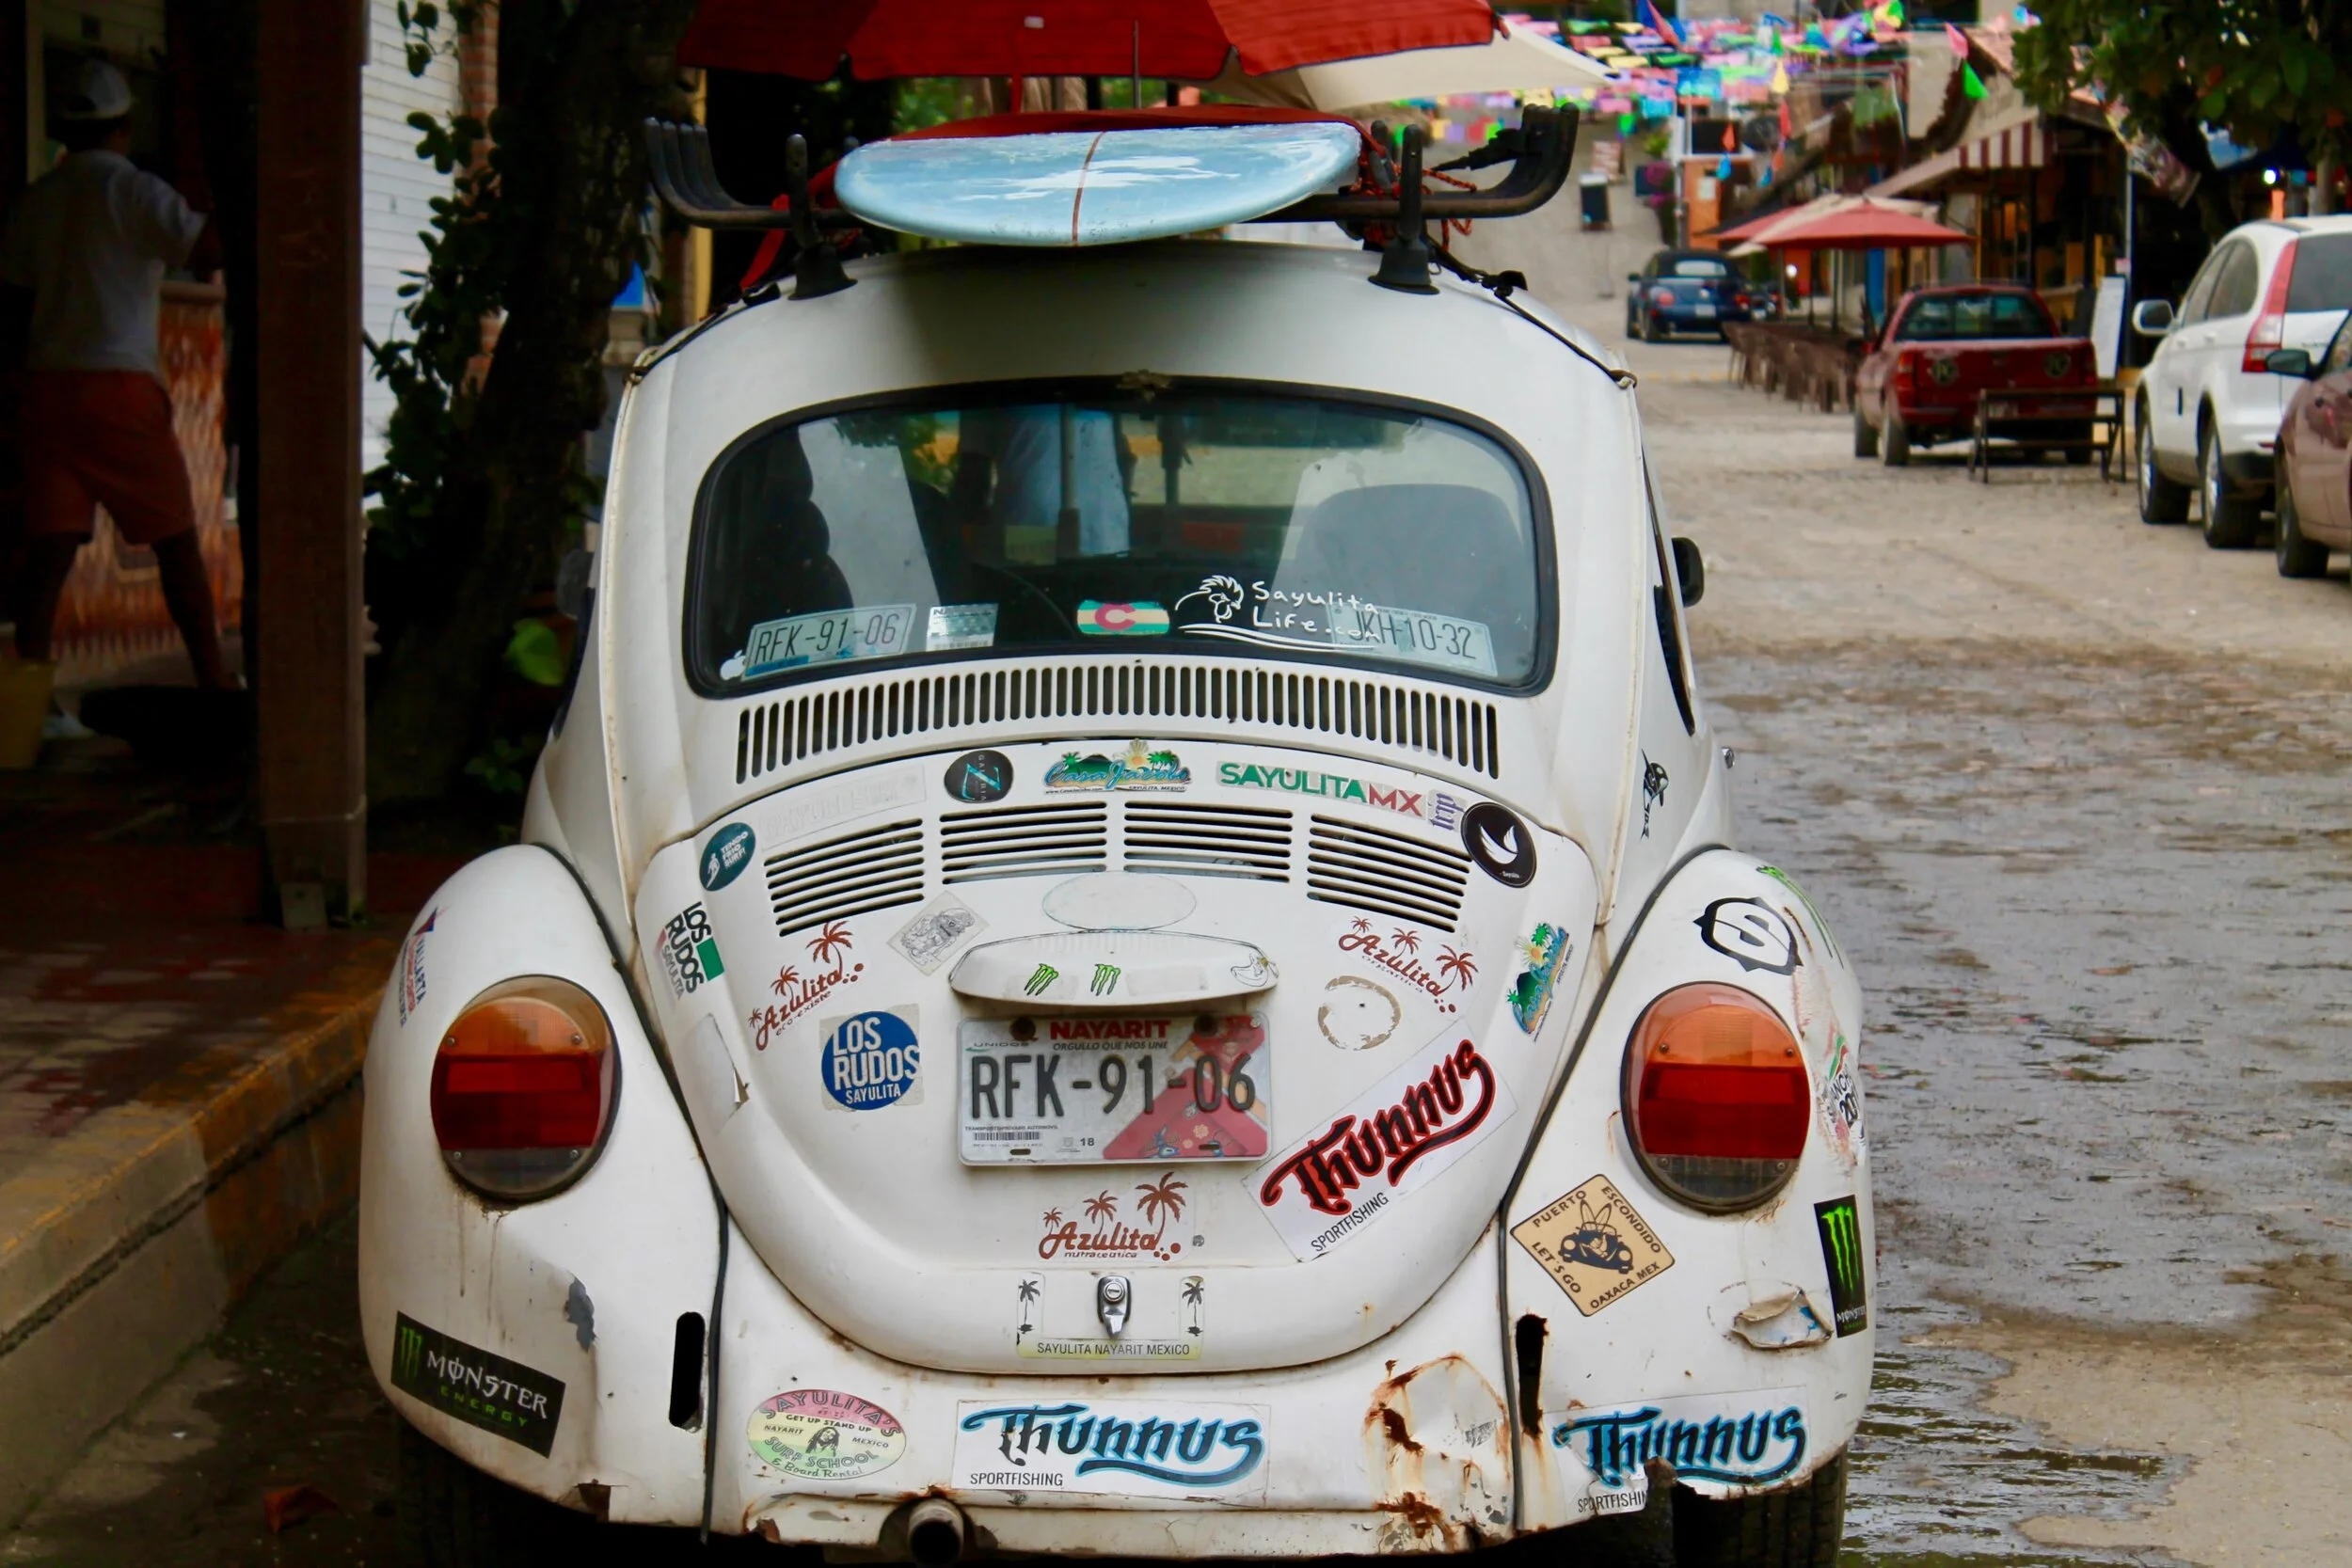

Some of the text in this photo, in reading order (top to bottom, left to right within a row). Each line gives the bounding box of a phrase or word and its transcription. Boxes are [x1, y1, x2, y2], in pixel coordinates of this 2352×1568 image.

[1252, 581, 1378, 614] Sayulita
[754, 613, 900, 664] RFK-91-06
[1350, 610, 1476, 659] JKH-10-32
[978, 754, 987, 800] GALRIA
[682, 901, 712, 943] LOS
[665, 913, 704, 993] RUDOS
[1339, 933, 1443, 997] Azulita
[755, 969, 843, 1051] Azulita
[1050, 1020, 1171, 1040] NAYARIT
[833, 1017, 882, 1056] LOS
[1053, 1040, 1168, 1052] ORGULLO QUE NOS UNE
[834, 1044, 922, 1091] RUDOS
[972, 1053, 1256, 1119] RFK-91-06
[846, 1083, 902, 1104] SAYULITA
[1080, 1137, 1095, 1147] 18
[1261, 1039, 1496, 1216] Thunnus
[1311, 1192, 1390, 1253] SPORTFISHING
[1533, 1190, 1587, 1227] PUERTO
[1601, 1185, 1661, 1254] ESCONDIDO
[1039, 1221, 1158, 1259] Azulita
[1562, 1273, 1581, 1293] GO
[1590, 1261, 1661, 1309] OAXACA MEX
[1037, 1342, 1190, 1355] SAYULITA NAYARIT MEXICO
[427, 1349, 548, 1419] MONSTER
[440, 1385, 528, 1427] ENERGY
[786, 1414, 803, 1422] GET
[823, 1419, 855, 1430] STAND
[764, 1424, 804, 1435] NAYARIT
[851, 1436, 889, 1449] MEXICO
[961, 1402, 1265, 1487] Thunnus
[1552, 1406, 1806, 1489] Thunnus
[764, 1436, 879, 1468] SURF SCHOOL
[783, 1462, 819, 1478] Board
[822, 1465, 865, 1478] Rental
[970, 1472, 1064, 1486] SPORTFISHING
[1577, 1490, 1648, 1513] SPORTFISHIN
